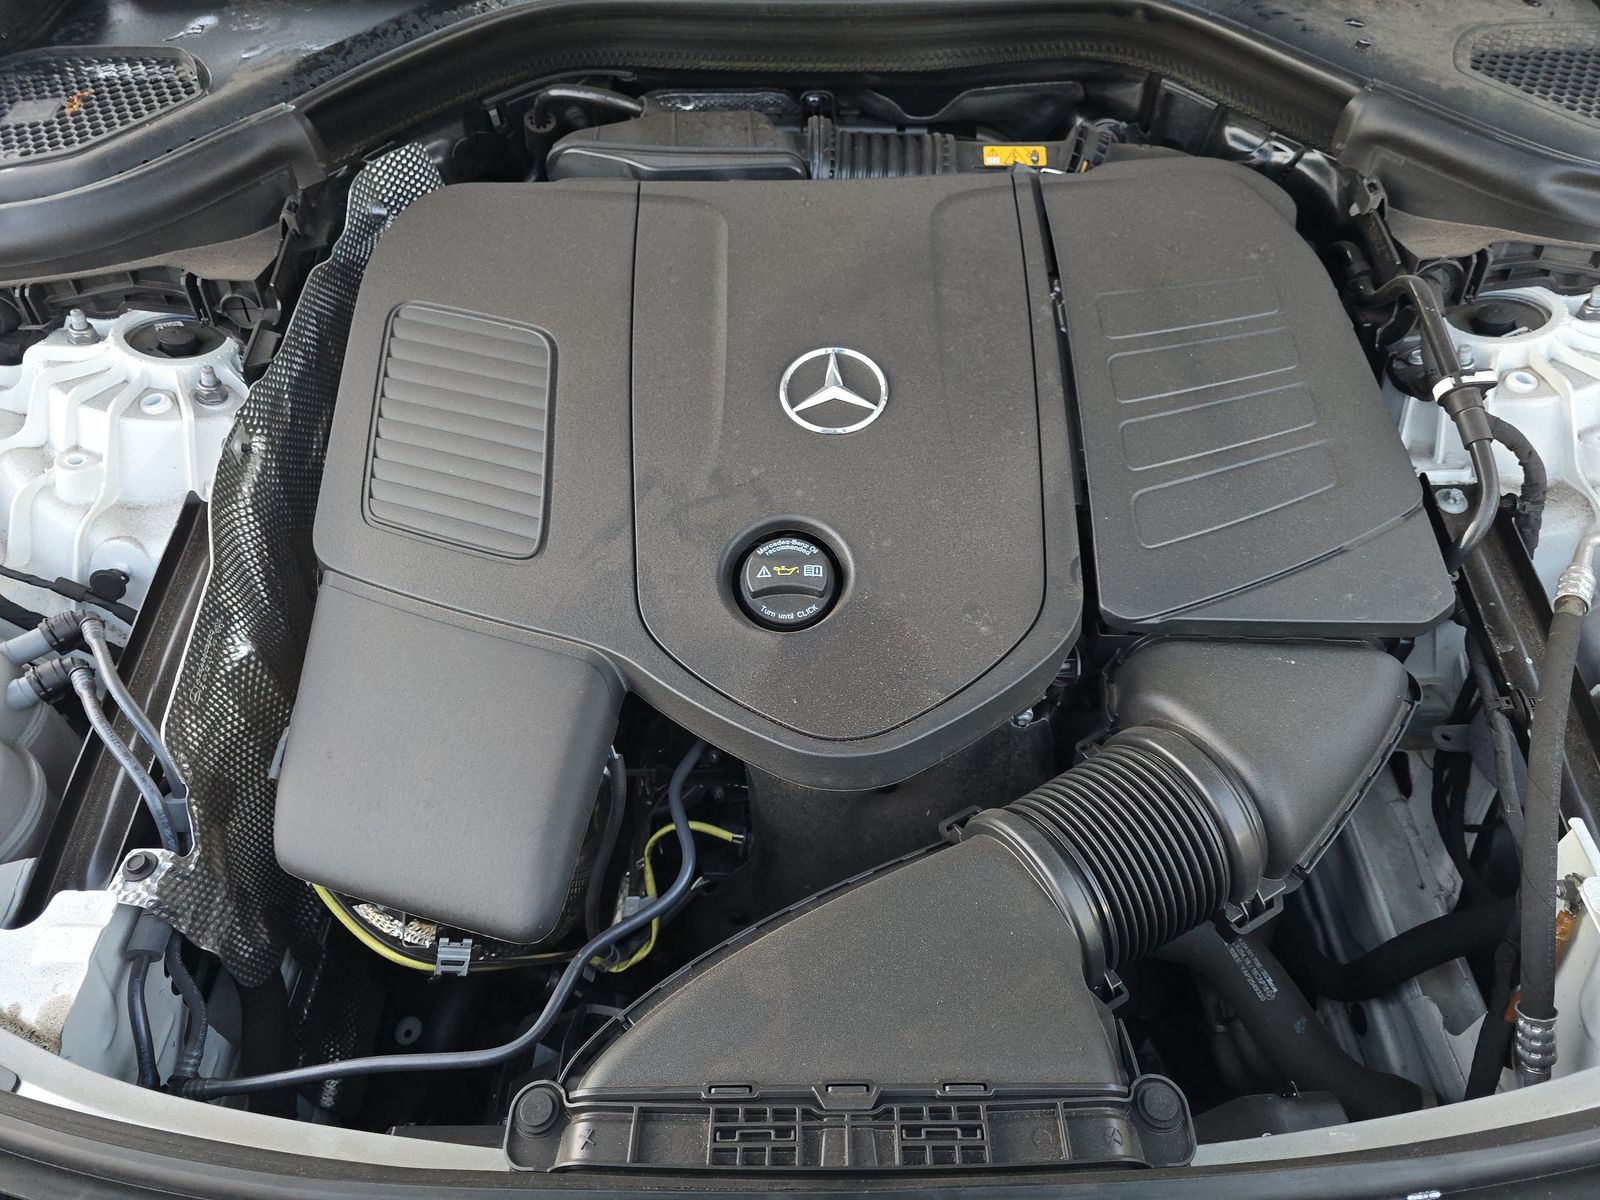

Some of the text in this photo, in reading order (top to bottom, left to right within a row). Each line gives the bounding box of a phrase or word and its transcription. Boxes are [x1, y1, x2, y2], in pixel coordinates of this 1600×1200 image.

[757, 539, 809, 555] Mercedes-Benz
[765, 544, 811, 556] recommended
[760, 605, 776, 618] Turn
[797, 604, 819, 618] CLICK
